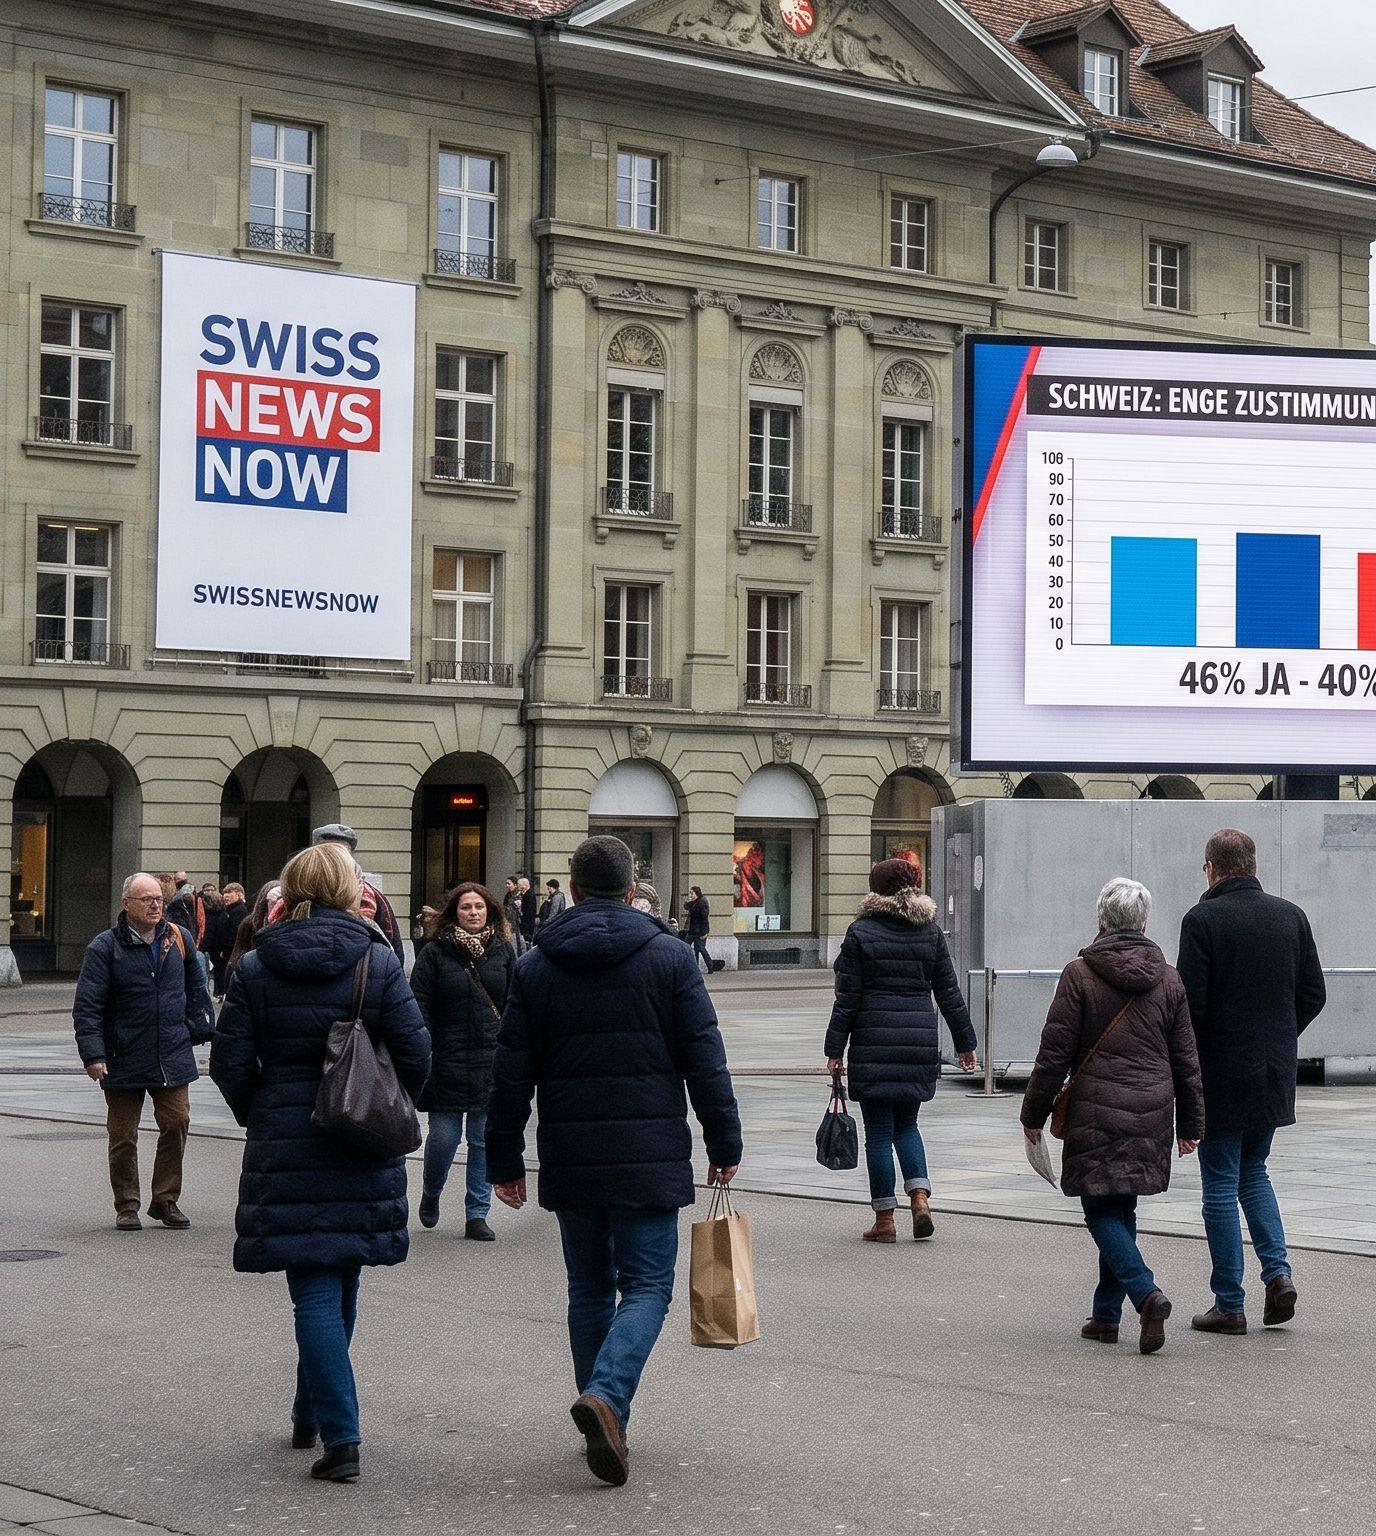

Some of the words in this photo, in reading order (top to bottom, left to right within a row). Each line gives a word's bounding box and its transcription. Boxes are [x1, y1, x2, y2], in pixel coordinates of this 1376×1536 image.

[200, 314, 380, 381] SWISS
[1048, 382, 1162, 413] SCHWEIZ:
[1168, 387, 1229, 416] ENGE
[204, 378, 373, 444] NEWS
[204, 444, 341, 504] NOW
[1049, 472, 1064, 486] 90
[1049, 493, 1064, 506] 70
[1048, 513, 1064, 527] 60
[1048, 534, 1064, 547] 50
[1048, 554, 1064, 568] 40
[1048, 575, 1064, 588] 30
[193, 583, 379, 614] SWISSNEWSNOW
[1048, 596, 1064, 609] 20
[1049, 616, 1064, 630] 10
[1055, 637, 1064, 651] 0
[1179, 661, 1246, 695] 46%
[1254, 662, 1291, 696] JA
